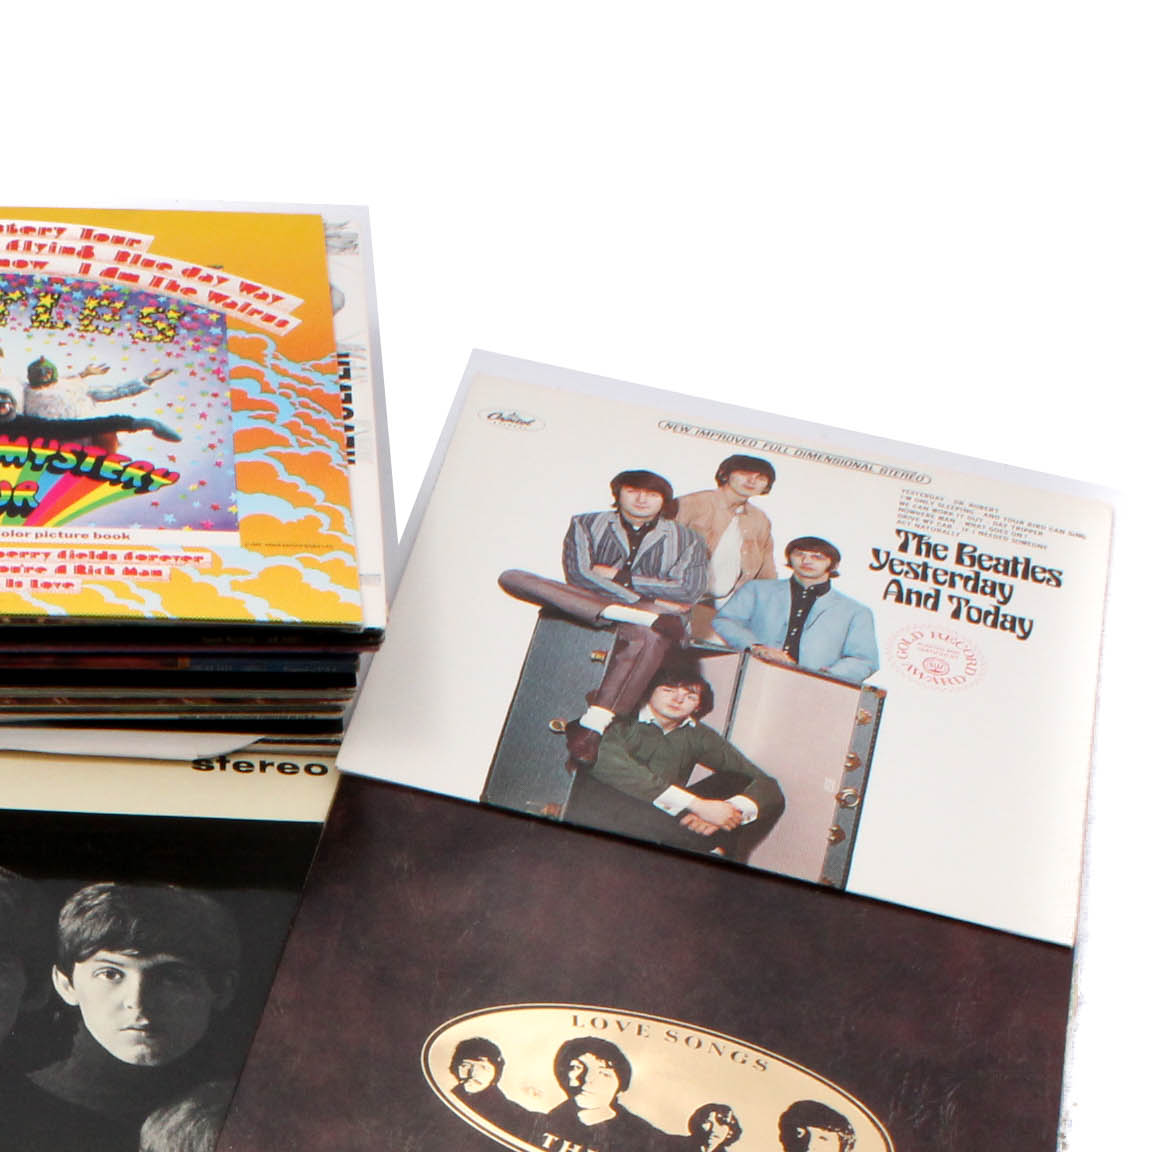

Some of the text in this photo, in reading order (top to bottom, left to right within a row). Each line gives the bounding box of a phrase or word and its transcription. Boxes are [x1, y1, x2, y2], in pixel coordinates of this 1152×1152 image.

[81, 228, 142, 248] Tour
[114, 249, 173, 271] Blue
[238, 280, 286, 304] Way
[149, 276, 199, 297] The
[207, 290, 290, 328] Walrus
[665, 421, 926, 483] NEW IMPROVED FULL DIMENSIONAL STEREO
[33, 531, 88, 542] picture
[92, 531, 131, 541] book
[74, 565, 116, 576] Rich
[122, 567, 163, 577] Man
[895, 528, 1064, 588] The Beatles
[30, 580, 76, 590] Love
[882, 578, 1034, 640] And Today
[897, 631, 925, 660] GOLD
[191, 756, 329, 777] stereo
[571, 1014, 769, 1073] LOVE SONGS
